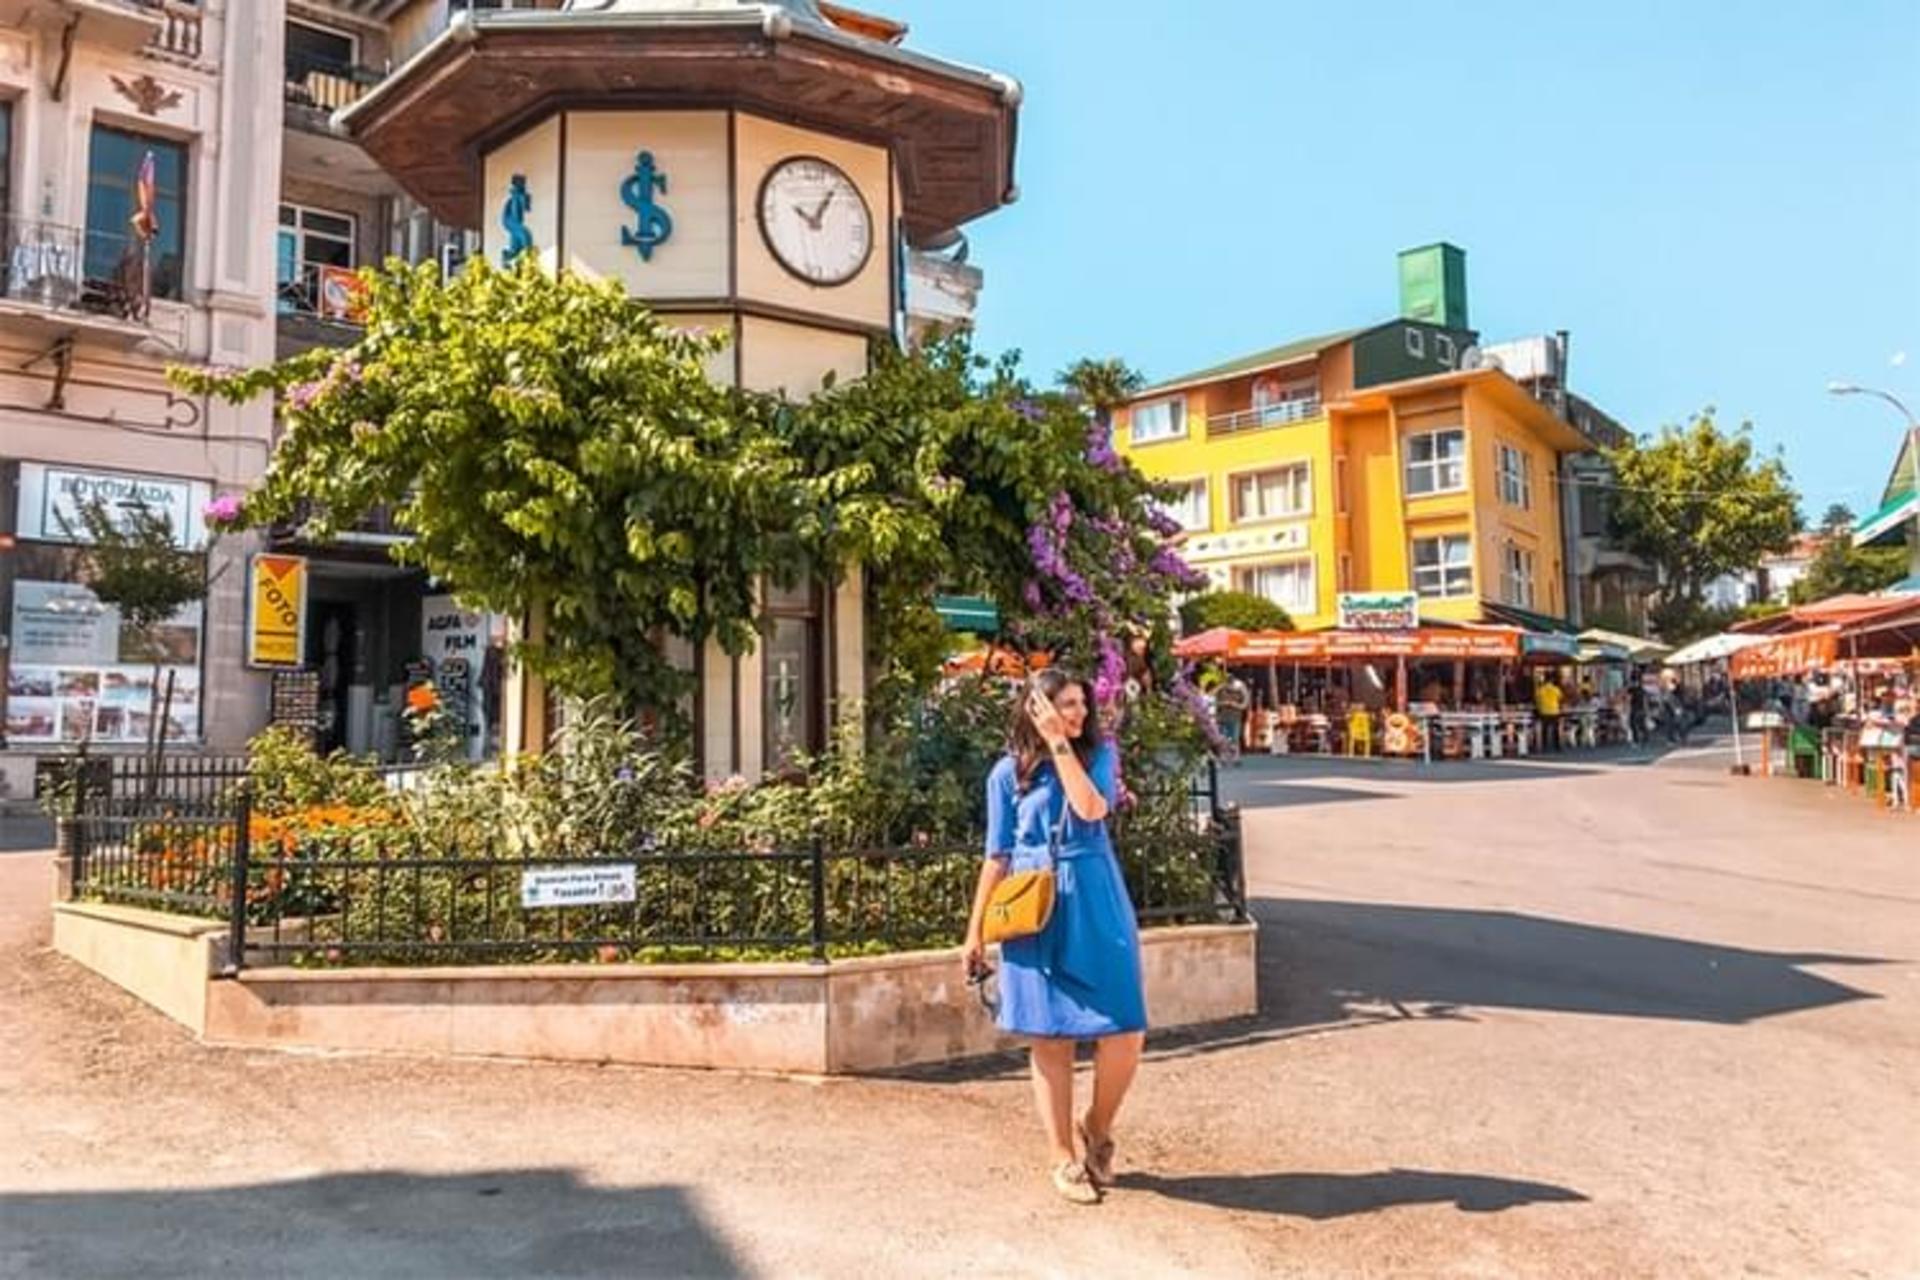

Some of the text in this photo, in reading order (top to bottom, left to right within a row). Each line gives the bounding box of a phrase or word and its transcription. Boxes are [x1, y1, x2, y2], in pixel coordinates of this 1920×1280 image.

[259, 577, 298, 627] FOTO
[427, 614, 462, 631] AGFA
[445, 634, 477, 650] FILM
